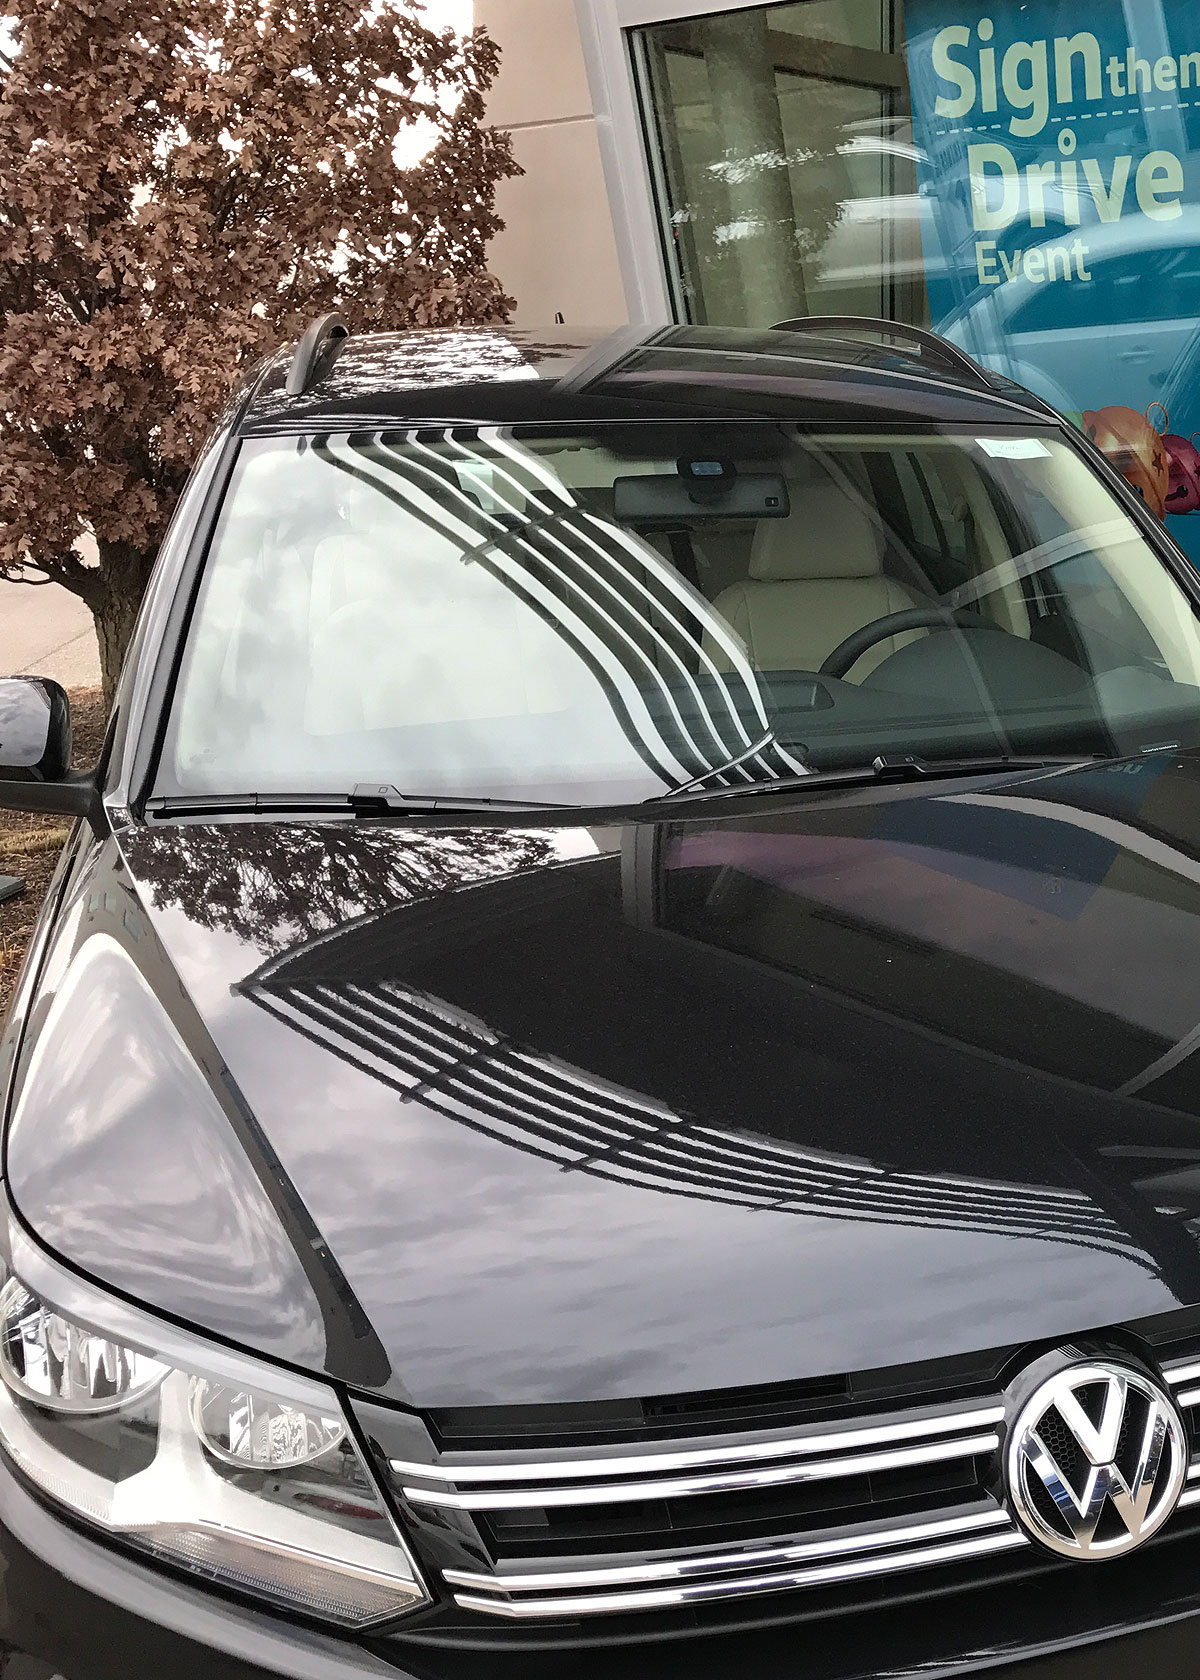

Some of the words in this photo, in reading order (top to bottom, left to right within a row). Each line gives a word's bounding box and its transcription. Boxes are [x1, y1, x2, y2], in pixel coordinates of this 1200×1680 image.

[931, 18, 1103, 138] Sign
[967, 128, 1184, 232] Drive
[975, 239, 1092, 285] Event
